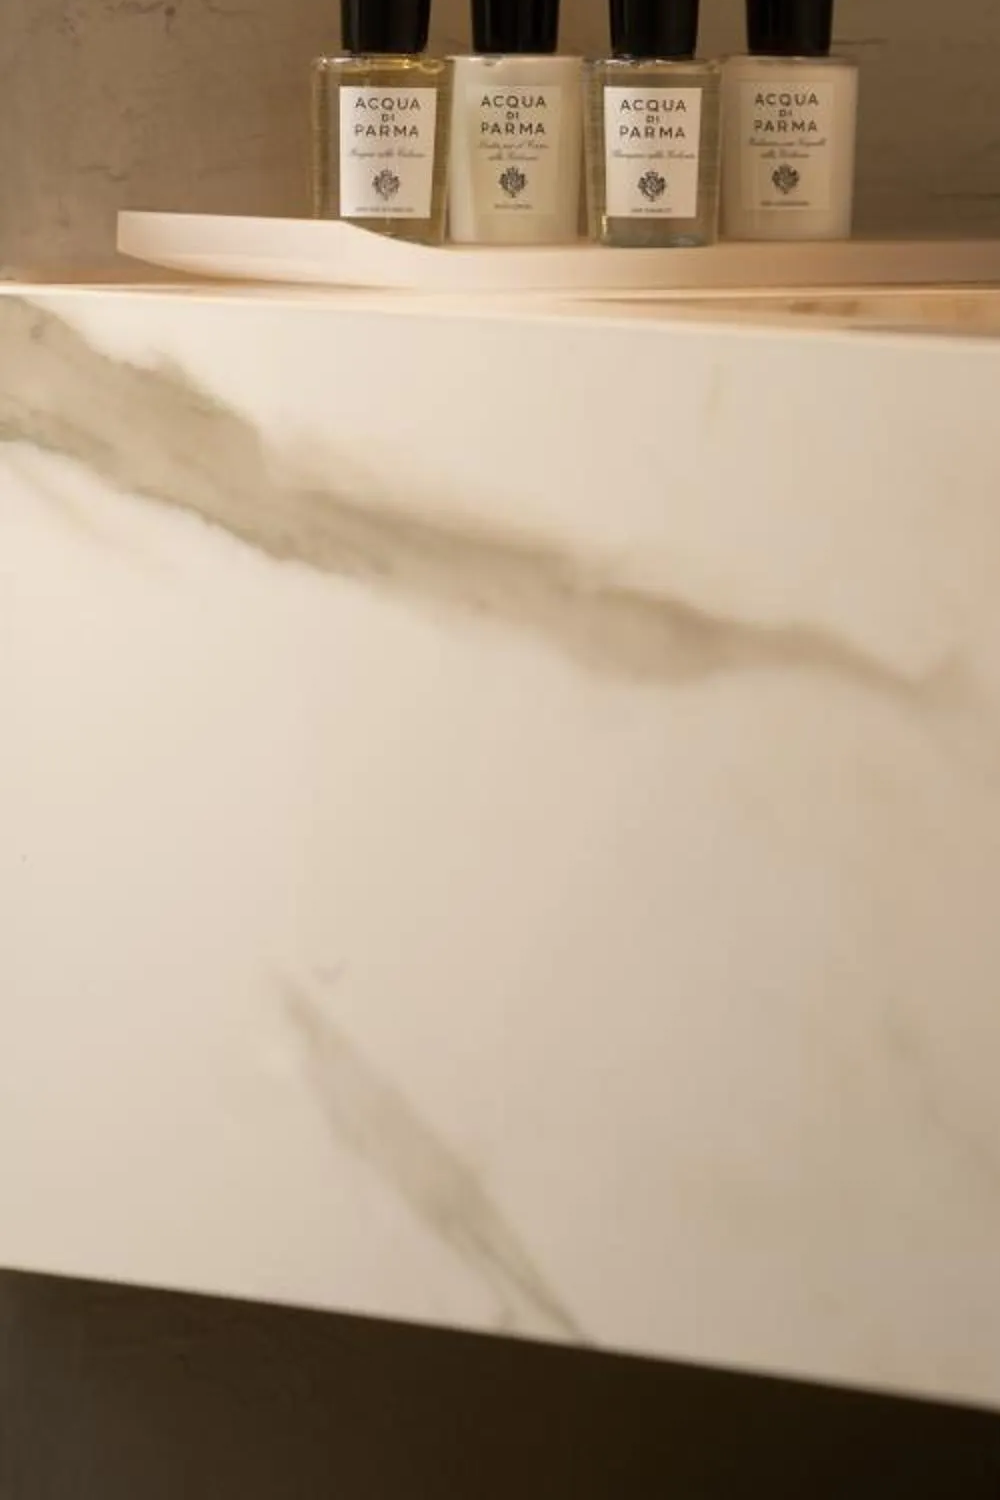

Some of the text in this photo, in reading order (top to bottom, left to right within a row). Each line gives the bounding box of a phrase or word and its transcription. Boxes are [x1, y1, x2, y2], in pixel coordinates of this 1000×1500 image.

[355, 97, 421, 110] ACQUA
[480, 95, 547, 108] ACQUA
[620, 99, 687, 112] ACQUA
[754, 92, 819, 106] ACQUA
[381, 113, 396, 123] DI
[506, 111, 519, 120] DI
[646, 115, 661, 124] DI
[778, 109, 793, 117] DI
[354, 124, 419, 137] PARMA
[480, 122, 545, 135] PARMA
[619, 126, 687, 139] PARMA
[754, 120, 818, 132] PARMA
